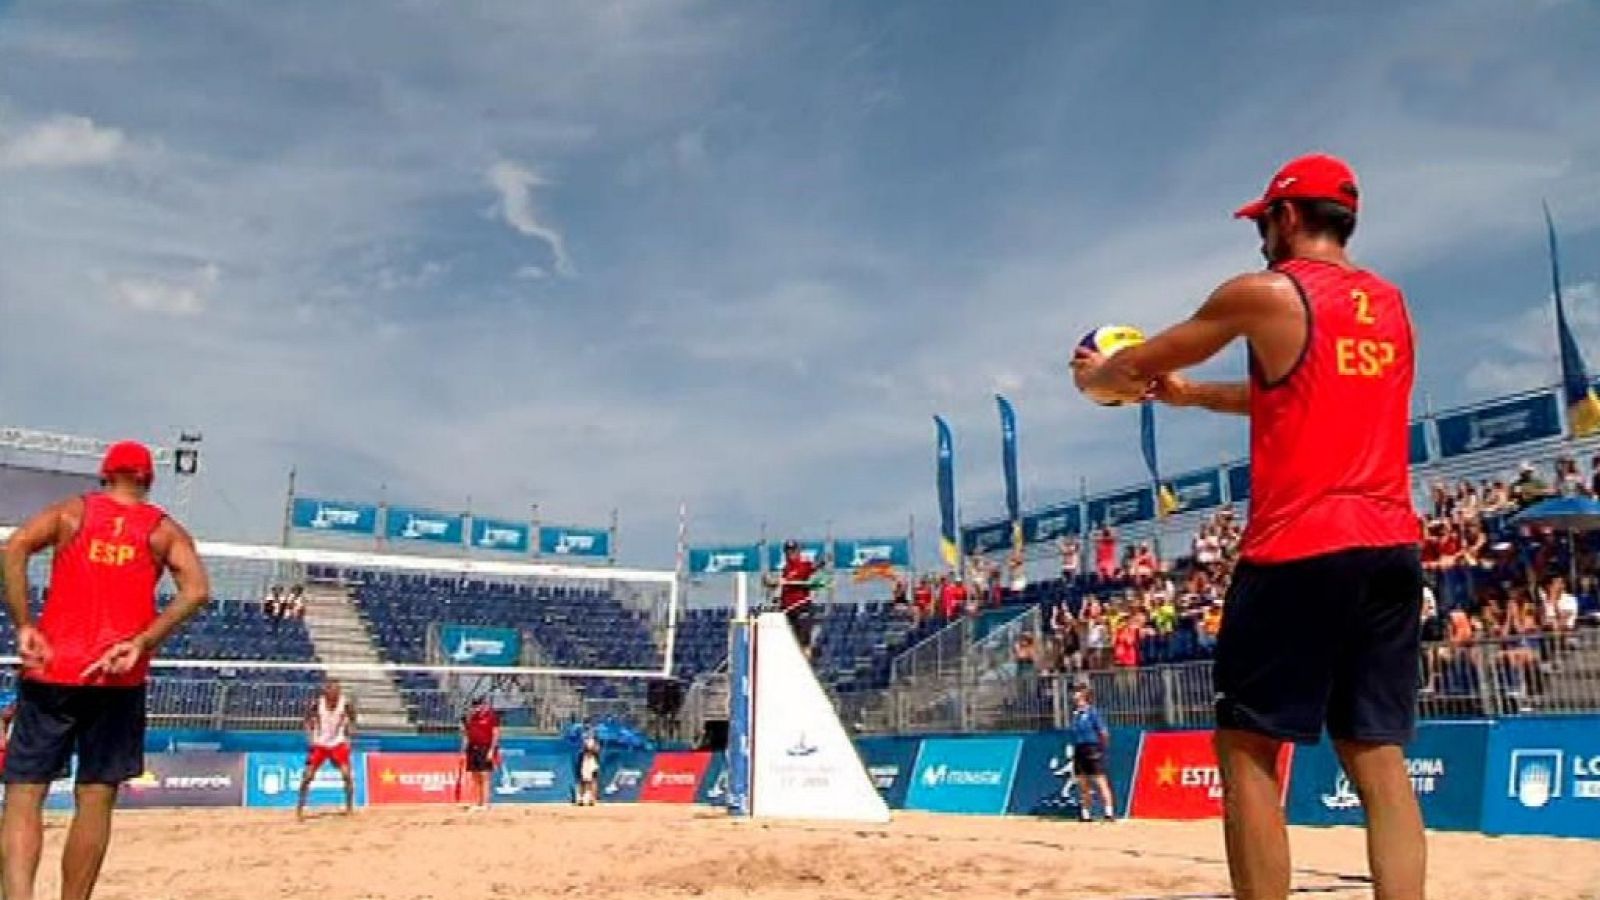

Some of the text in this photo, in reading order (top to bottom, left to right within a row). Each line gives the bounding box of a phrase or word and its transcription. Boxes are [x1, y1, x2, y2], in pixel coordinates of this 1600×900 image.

[1350, 289, 1376, 325] 2
[1336, 338, 1395, 376] ESP
[89, 539, 136, 566] ESP
